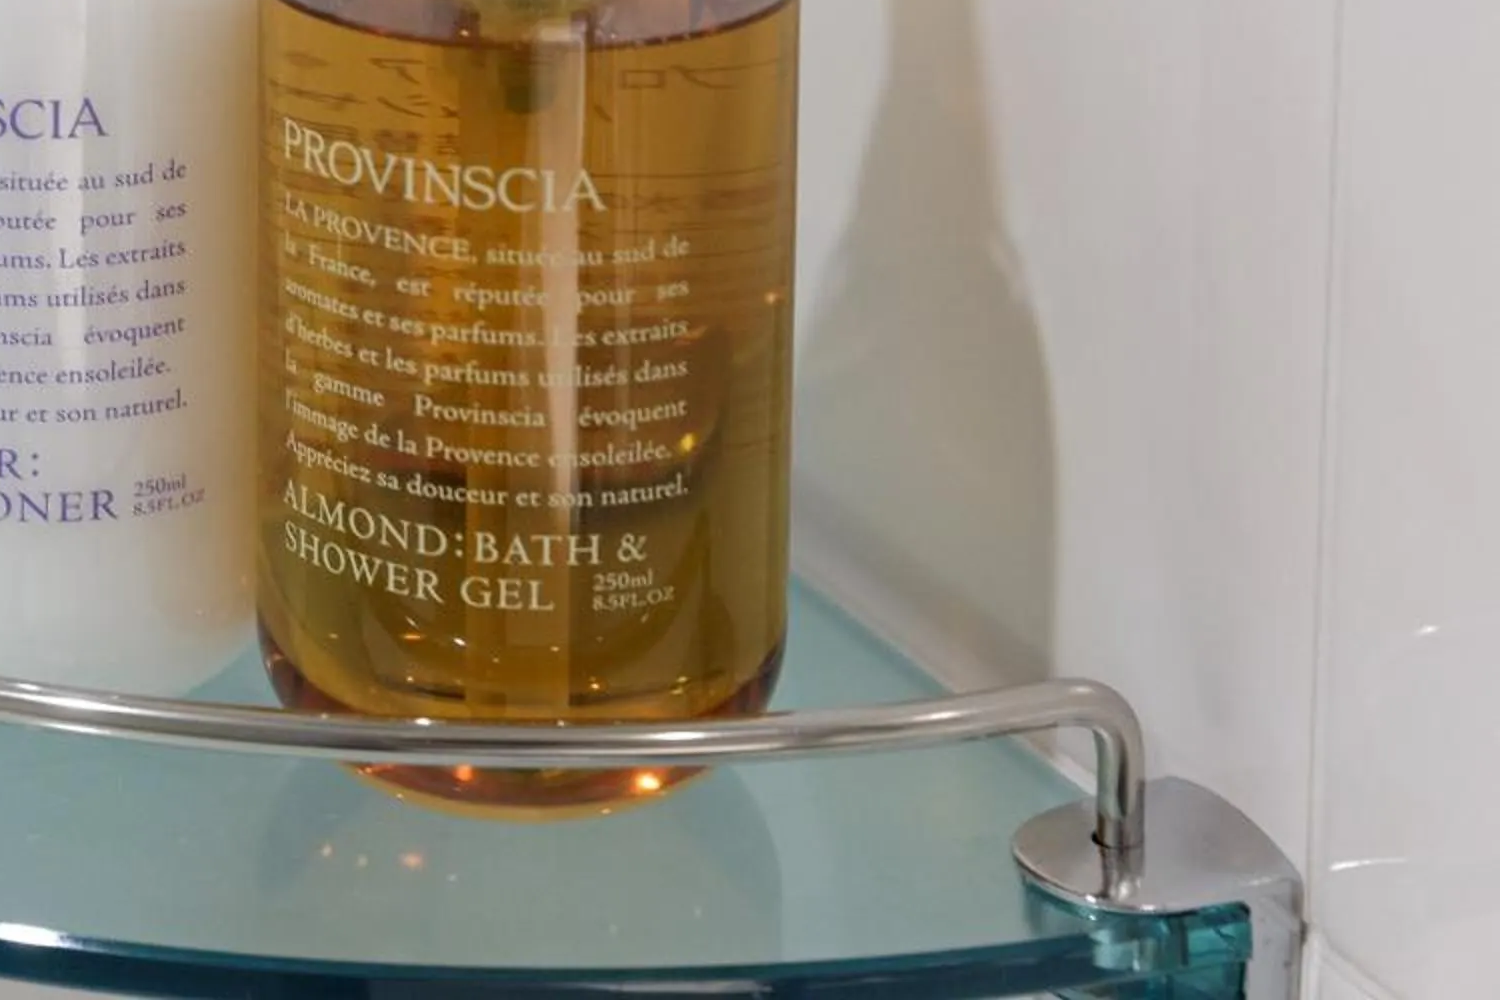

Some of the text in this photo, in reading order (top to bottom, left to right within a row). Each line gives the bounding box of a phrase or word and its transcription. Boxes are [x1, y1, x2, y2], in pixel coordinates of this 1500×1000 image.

[0, 170, 69, 191] située
[78, 172, 105, 189] au
[114, 164, 153, 188] sud
[161, 160, 187, 180] de
[283, 118, 607, 213] PROVINSCIA
[81, 211, 137, 235] pour
[155, 203, 187, 221] ses
[285, 191, 306, 222] LA
[313, 205, 477, 263] PROVENCE,
[612, 238, 654, 263] sud
[661, 235, 690, 258] de
[59, 248, 99, 269] Les
[105, 240, 186, 265] extraits
[47, 283, 130, 308] utilisés
[136, 278, 186, 301] dans
[309, 245, 375, 286] France,
[396, 275, 432, 297] est
[454, 284, 548, 311] réputée
[576, 288, 637, 314] pour
[657, 281, 690, 298] ses
[285, 276, 358, 320] aromates
[364, 310, 384, 327] et
[390, 316, 425, 336] ses
[432, 317, 543, 347] parfums.
[602, 319, 688, 346] extraits
[83, 316, 186, 348] évoquent
[285, 313, 354, 358] d'herbes
[359, 346, 380, 366] et
[386, 343, 417, 375] les
[425, 352, 529, 387] parfums
[634, 359, 688, 383] dans
[25, 406, 49, 422] et
[56, 405, 97, 422] son
[105, 389, 188, 420] naturel.
[286, 348, 688, 432] la gamme Provinscia évoquent
[365, 424, 389, 448] de
[398, 430, 417, 456] la
[425, 437, 539, 467] Provence
[133, 471, 187, 498] 250ml
[285, 429, 689, 507] Appréciez sa douceur et son naturel.
[285, 520, 554, 611] SHOWER GEL
[474, 533, 603, 566] BATH
[617, 533, 647, 562] &
[593, 567, 653, 591] 250ml
